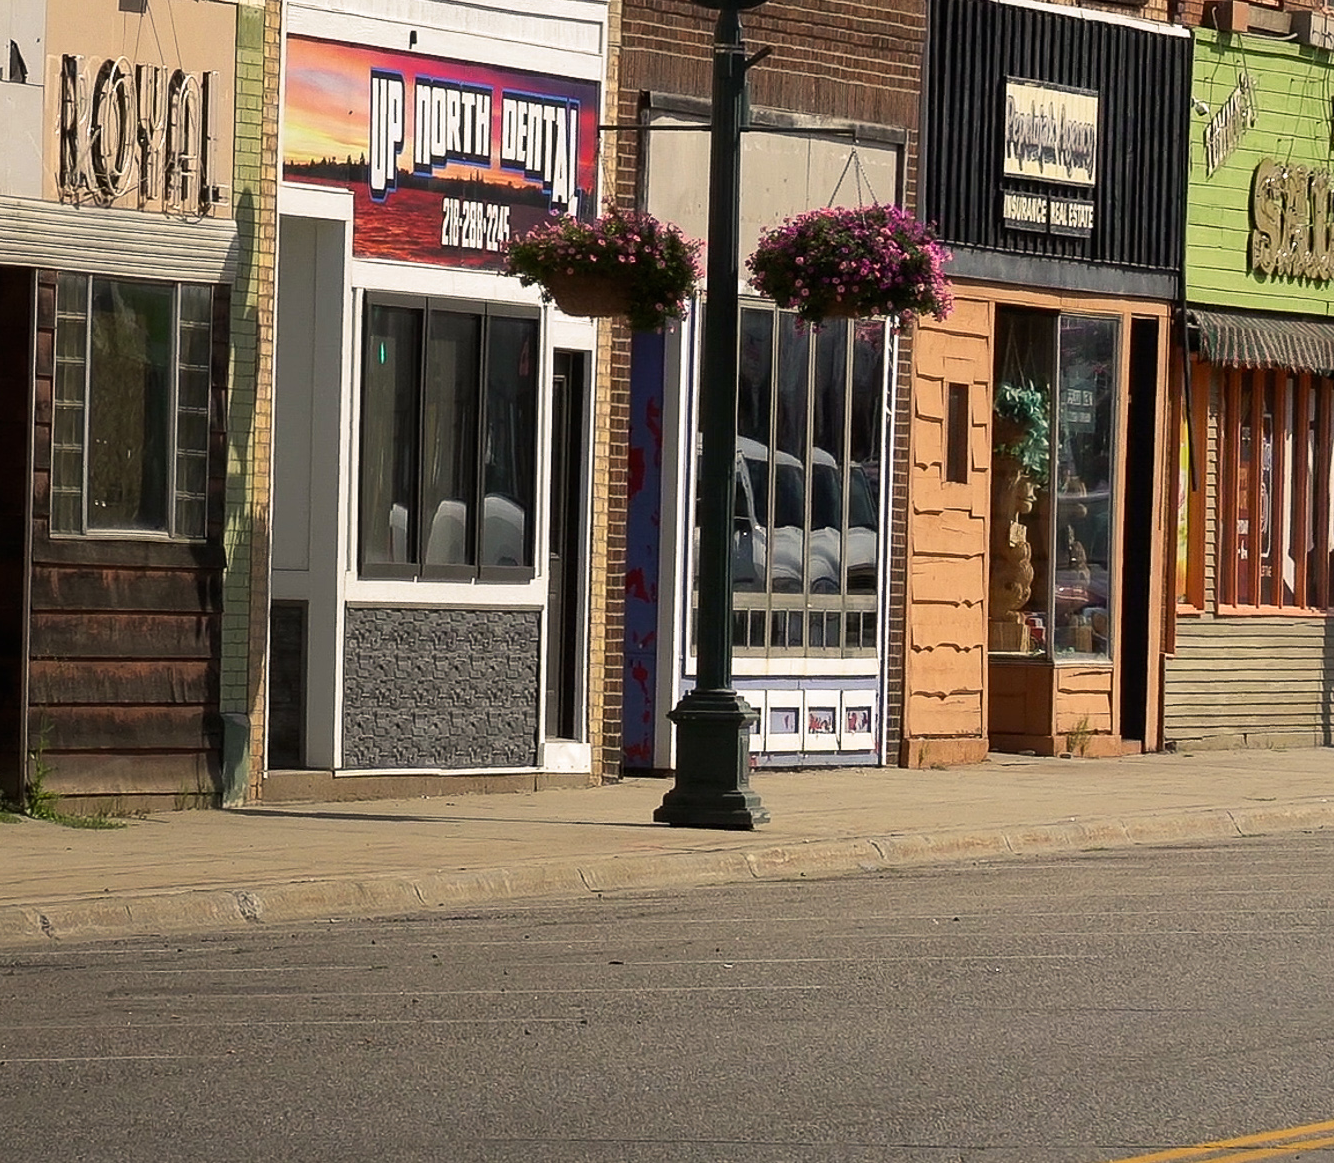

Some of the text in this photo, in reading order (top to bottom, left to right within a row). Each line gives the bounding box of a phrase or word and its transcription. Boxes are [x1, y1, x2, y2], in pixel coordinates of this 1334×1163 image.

[59, 52, 229, 212] ROYAL
[370, 74, 578, 218] UP NORTH DENTAL
[1003, 194, 1094, 229] INSURANCE REAL ESTATE
